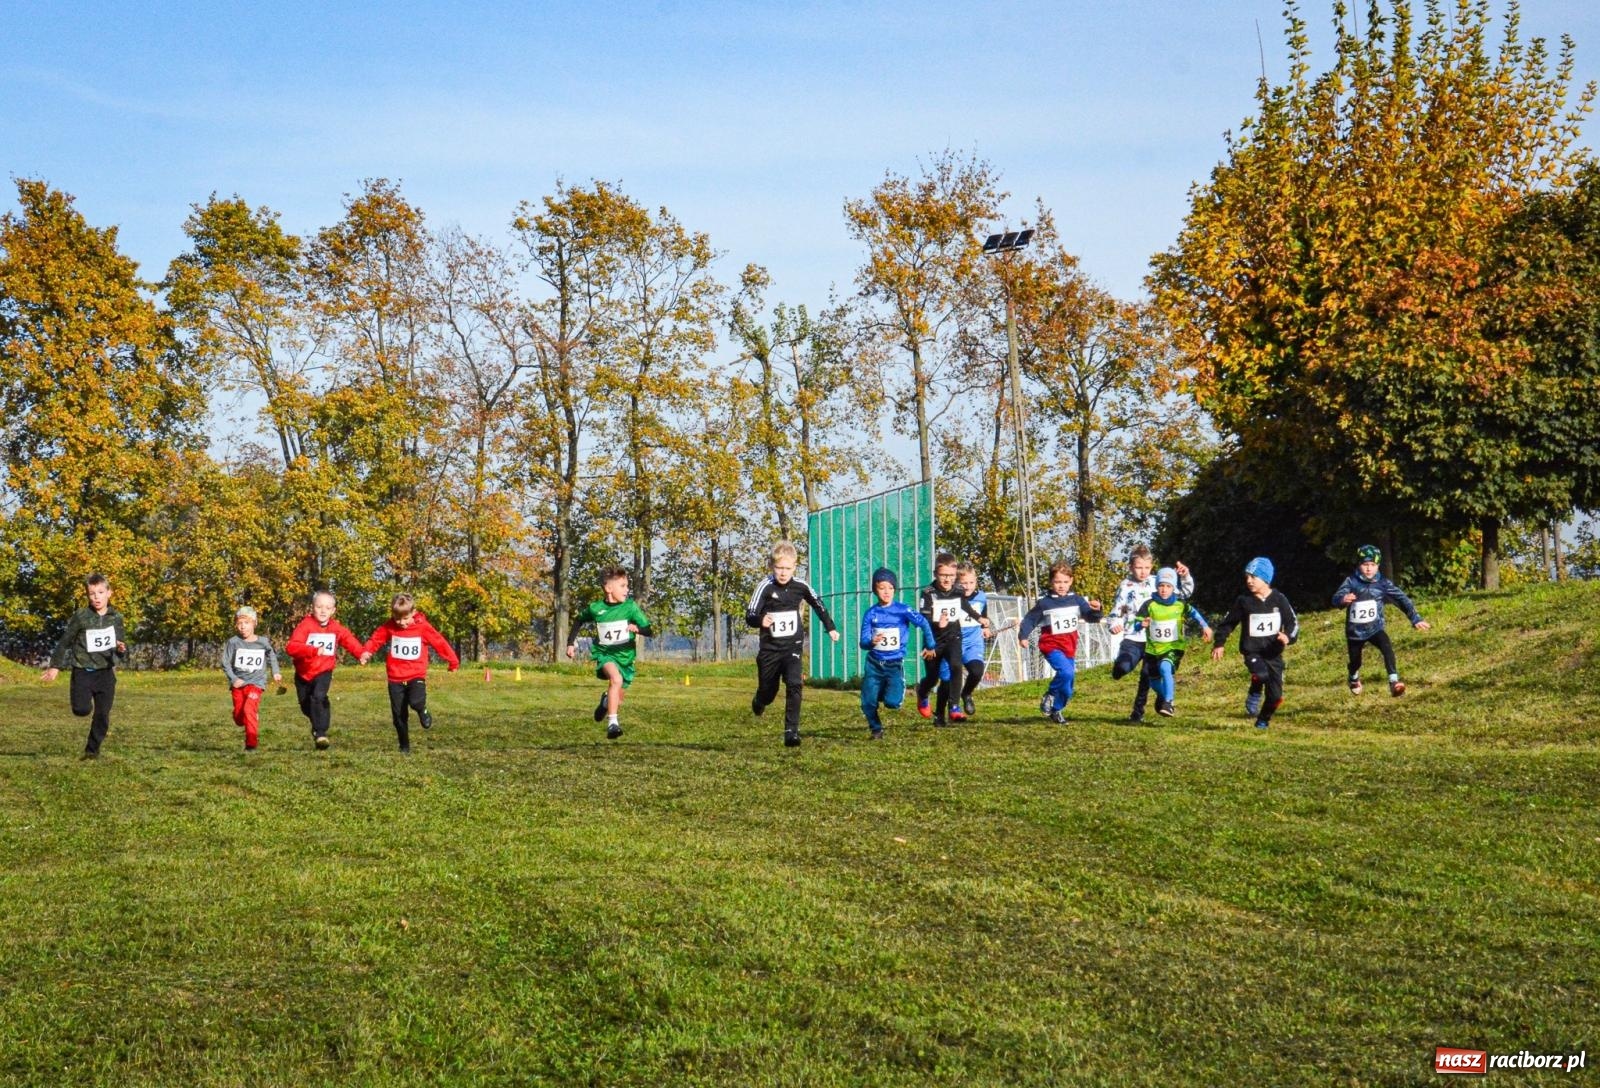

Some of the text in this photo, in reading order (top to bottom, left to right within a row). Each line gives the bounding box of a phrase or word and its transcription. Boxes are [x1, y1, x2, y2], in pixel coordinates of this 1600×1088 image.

[1351, 608, 1375, 619] 126
[770, 620, 794, 633] 131
[1054, 617, 1077, 630] 135
[1257, 621, 1273, 632] 41
[604, 630, 622, 641] 47
[1155, 628, 1172, 638] 38
[94, 635, 111, 648] 52
[881, 636, 898, 647] 33
[393, 644, 419, 656] 108
[238, 656, 262, 666] 120
